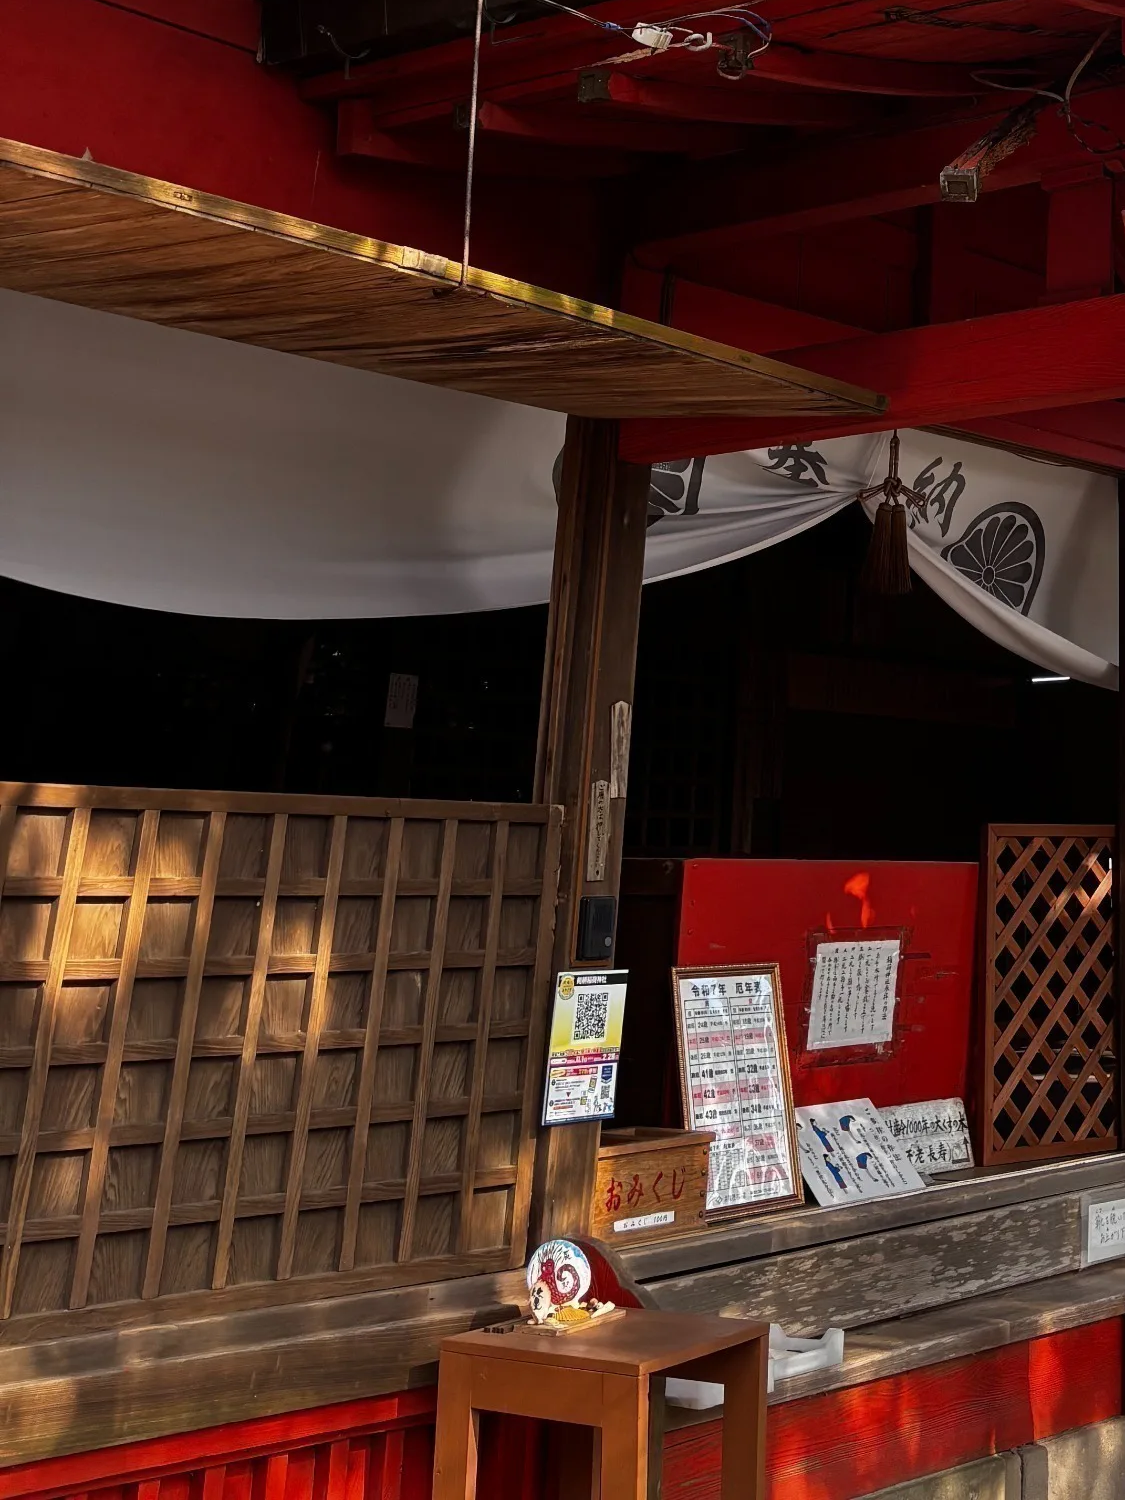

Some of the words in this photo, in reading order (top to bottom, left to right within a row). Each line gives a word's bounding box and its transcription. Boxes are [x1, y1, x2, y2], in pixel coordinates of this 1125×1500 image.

[906, 456, 966, 538] 納
[690, 983, 727, 998] 令和7年
[605, 1166, 686, 1212] おみくじ
[623, 1218, 647, 1229] おみくじ
